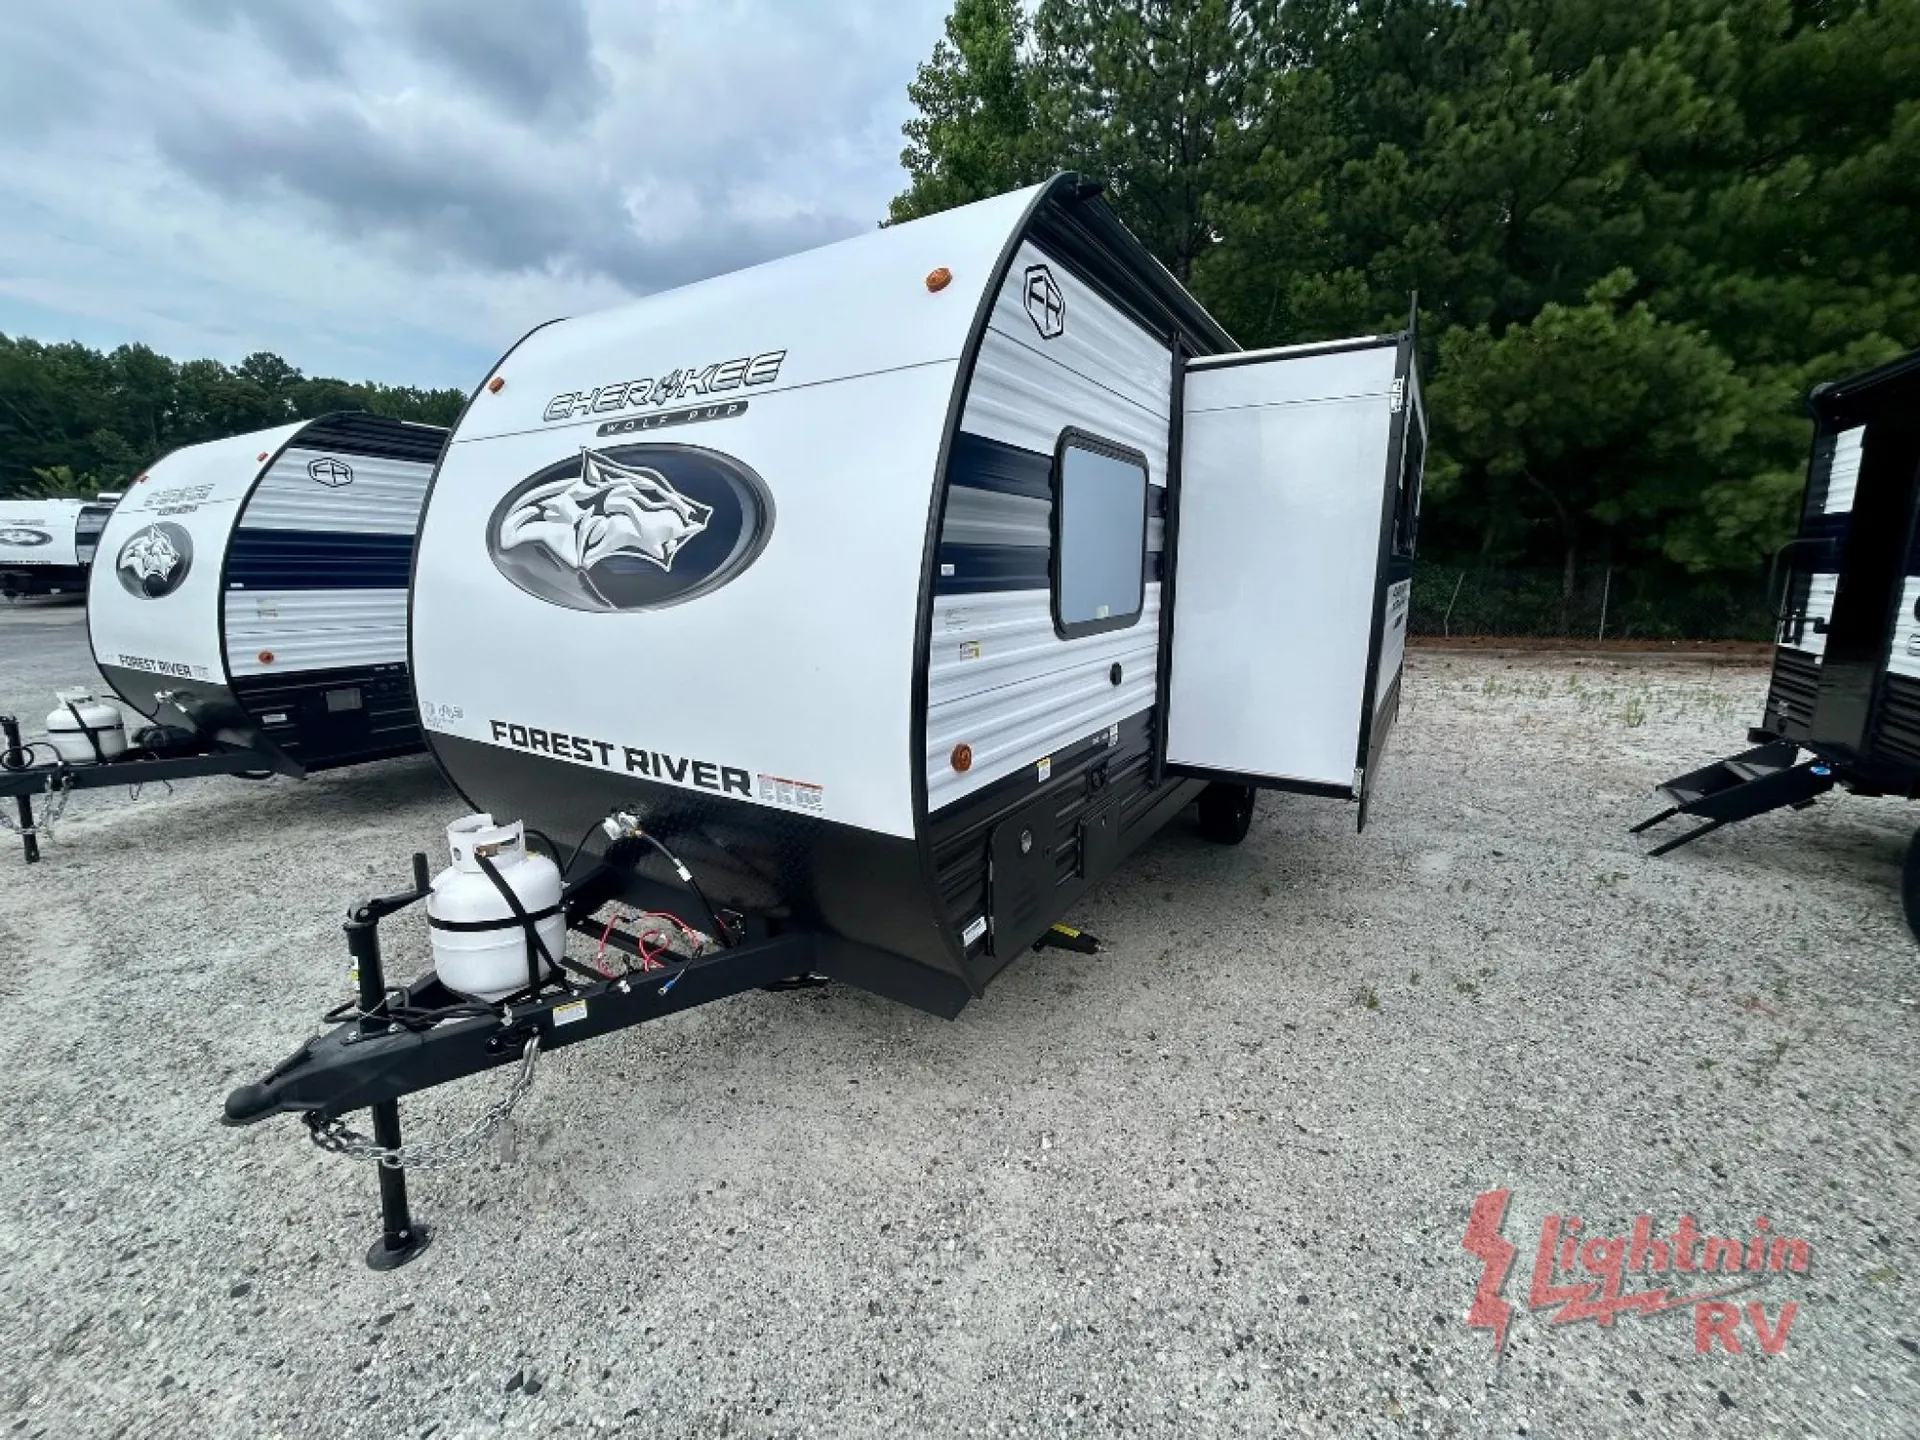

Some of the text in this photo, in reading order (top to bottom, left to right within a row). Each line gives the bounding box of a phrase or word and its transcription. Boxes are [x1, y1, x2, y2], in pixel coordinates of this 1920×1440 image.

[606, 403, 738, 433] WOLF PUP
[489, 719, 615, 766] FOREST
[621, 745, 753, 798] RIVER
